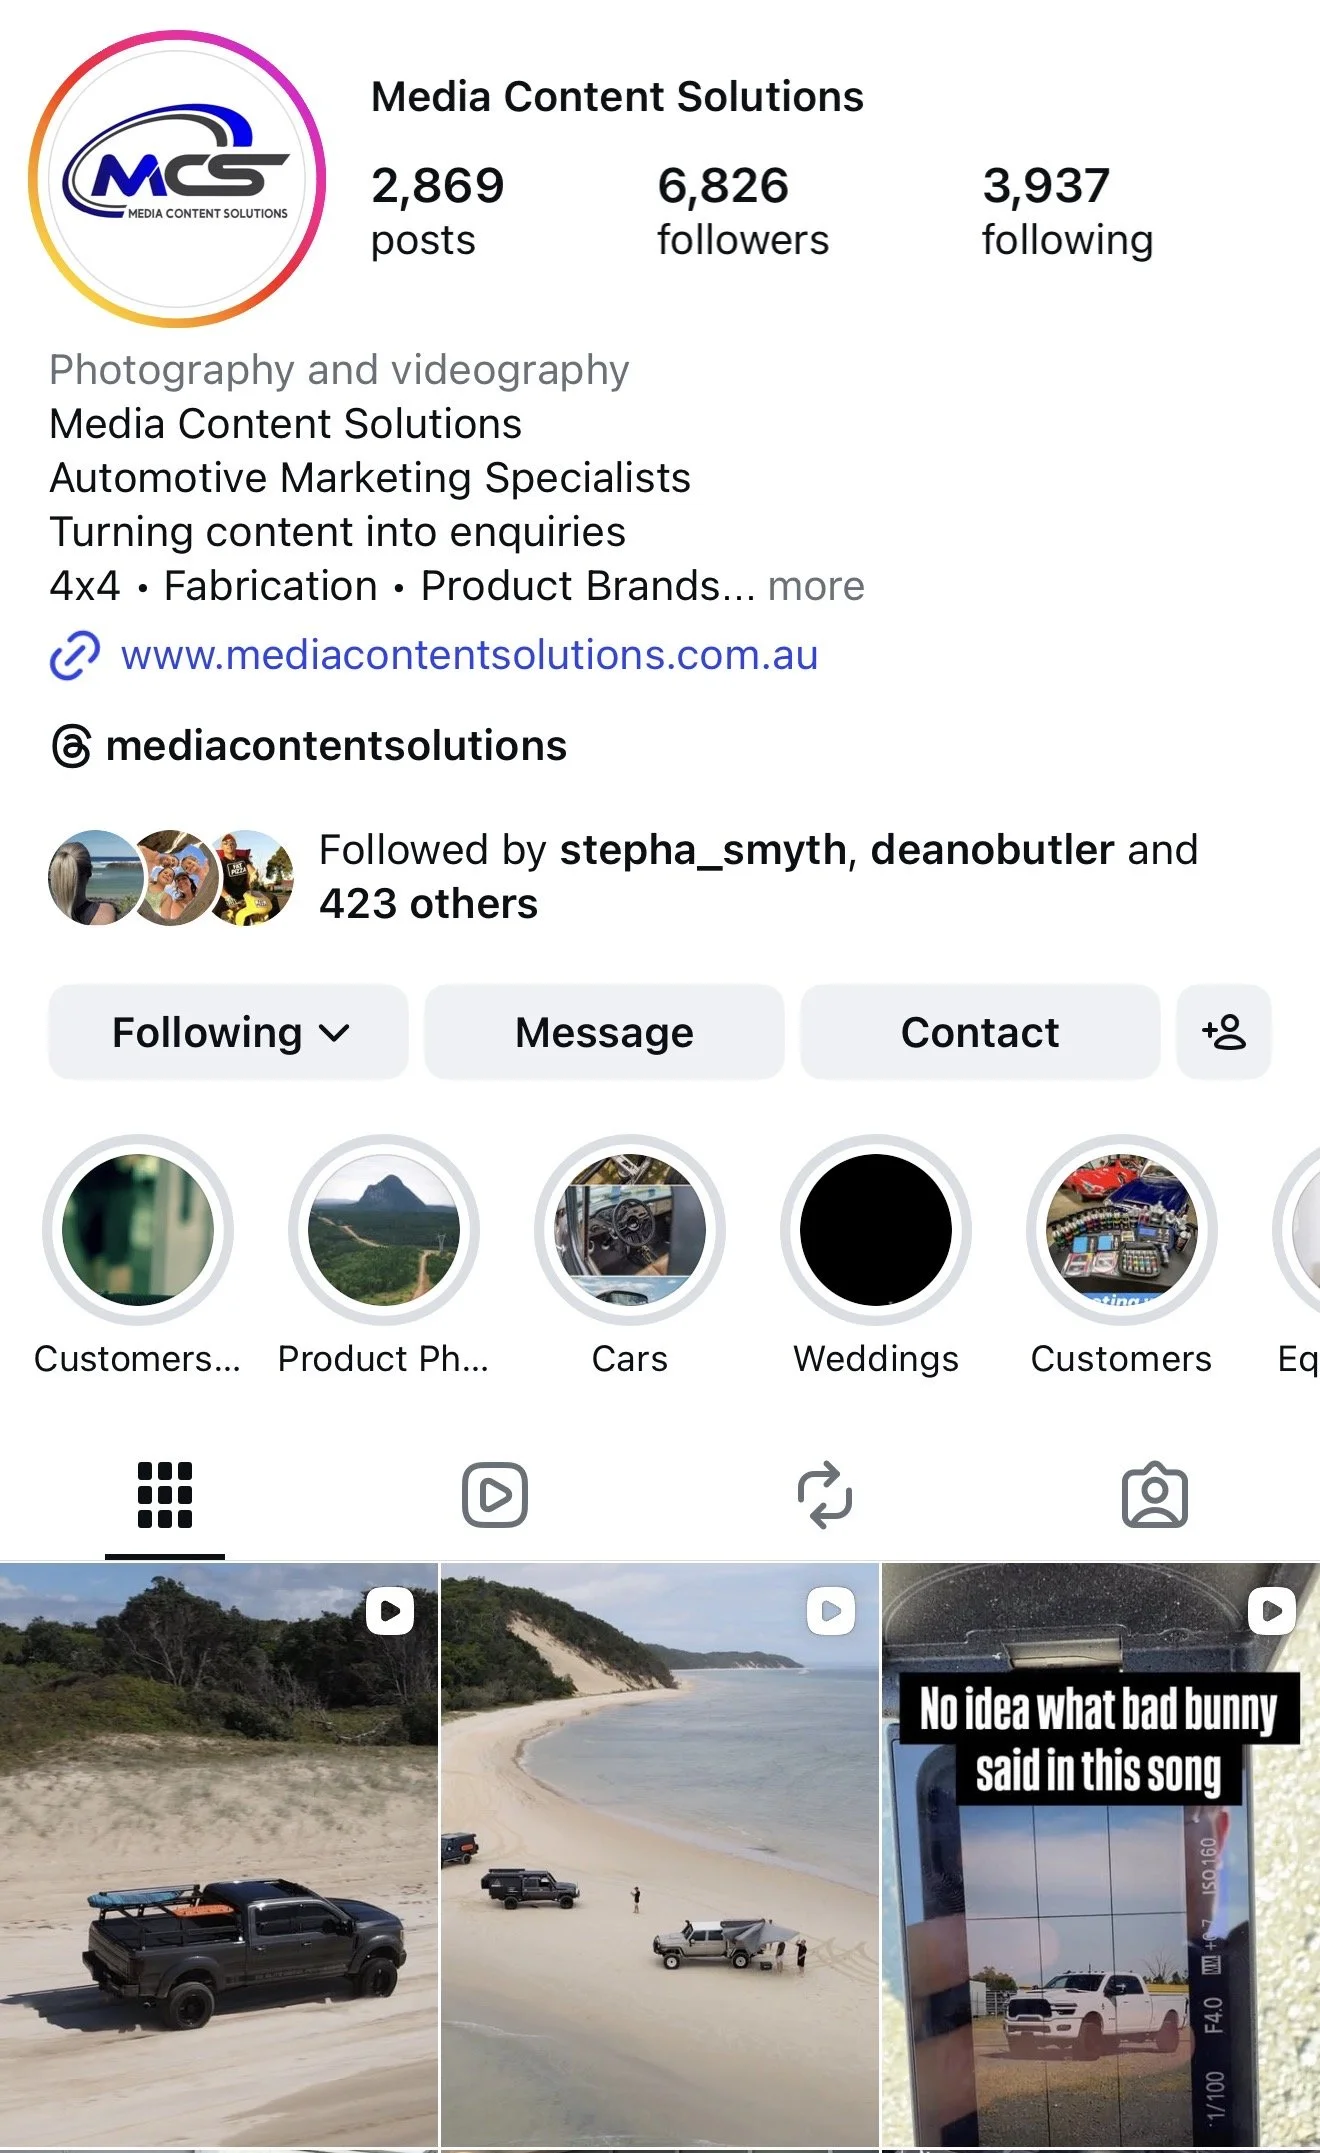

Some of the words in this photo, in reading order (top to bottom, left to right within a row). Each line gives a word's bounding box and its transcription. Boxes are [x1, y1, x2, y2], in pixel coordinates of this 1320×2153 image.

[372, 78, 490, 113] Media
[504, 79, 665, 113] Content
[677, 78, 864, 113] Solutions
[91, 153, 291, 197] MCS
[372, 166, 504, 212] 2,869
[658, 166, 789, 212] 6,826
[983, 166, 1110, 212] 3,937
[128, 208, 163, 219] MEDIA
[166, 208, 221, 219] CONTENT
[223, 208, 288, 219] SOLUTIONS
[372, 225, 476, 263] posts
[656, 222, 830, 256] followers
[981, 222, 1153, 263] following
[51, 352, 295, 393] Photography
[308, 352, 377, 385] and
[391, 352, 630, 393] videography
[50, 406, 164, 440] Media
[178, 407, 332, 440] Content
[344, 406, 522, 440] Solutions
[49, 460, 267, 494] Automotive
[281, 460, 471, 501] Marketing
[485, 460, 691, 501] Specialists
[49, 514, 193, 555] Turning
[206, 517, 354, 548] content
[367, 514, 437, 548] into
[450, 514, 626, 555] enquiries
[49, 569, 121, 601] 4x4
[166, 568, 377, 602] Fabrication
[423, 568, 573, 602] Product
[587, 568, 754, 602] Brands...
[769, 576, 865, 601] more
[120, 637, 817, 671] www.mediacontentsolutions.com.au
[107, 727, 567, 762] mediacontentsolutions
[321, 832, 488, 866] Followed
[503, 832, 547, 873] by
[560, 832, 856, 873] stepha_smyth,
[871, 832, 1116, 866] deanobutler
[1128, 832, 1198, 866] and
[319, 886, 397, 920] 423
[410, 886, 538, 920] others
[113, 1014, 302, 1056] Following
[516, 1016, 694, 1056] Message
[901, 1016, 1060, 1049] Contact
[34, 1344, 240, 1373] Customers...
[279, 1343, 408, 1373] Product
[420, 1343, 488, 1372] Ph...
[592, 1344, 668, 1373] Cars
[793, 1343, 959, 1379] Weddings
[1031, 1344, 1212, 1373] Customers
[1279, 1344, 1318, 1379] Eq
[1203, 1997, 1224, 2034] F4.0
[1205, 2071, 1226, 2118] 1/100
